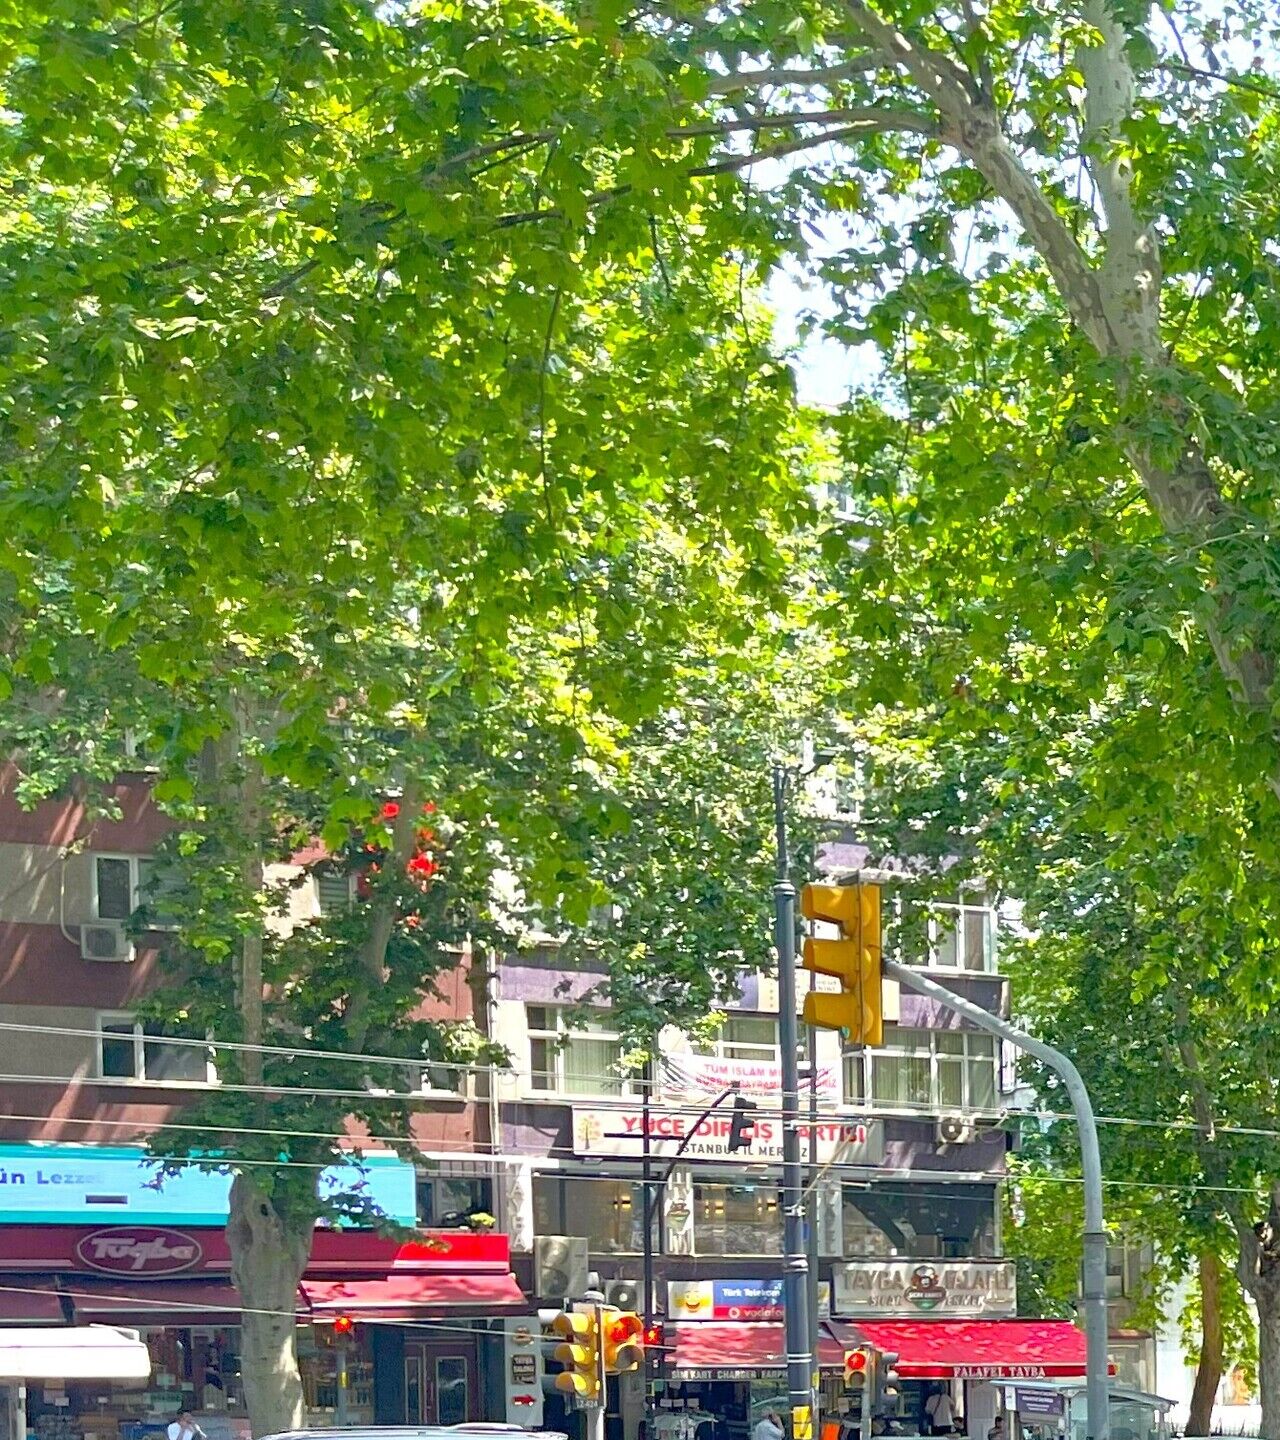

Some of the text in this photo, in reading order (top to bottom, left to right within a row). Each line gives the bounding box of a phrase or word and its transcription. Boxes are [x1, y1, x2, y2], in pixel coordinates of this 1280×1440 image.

[697, 1116, 773, 1143] DİRLİŞ
[743, 1307, 785, 1318] vodafo
[953, 1366, 1046, 1378] FALAFEL TAYBA
